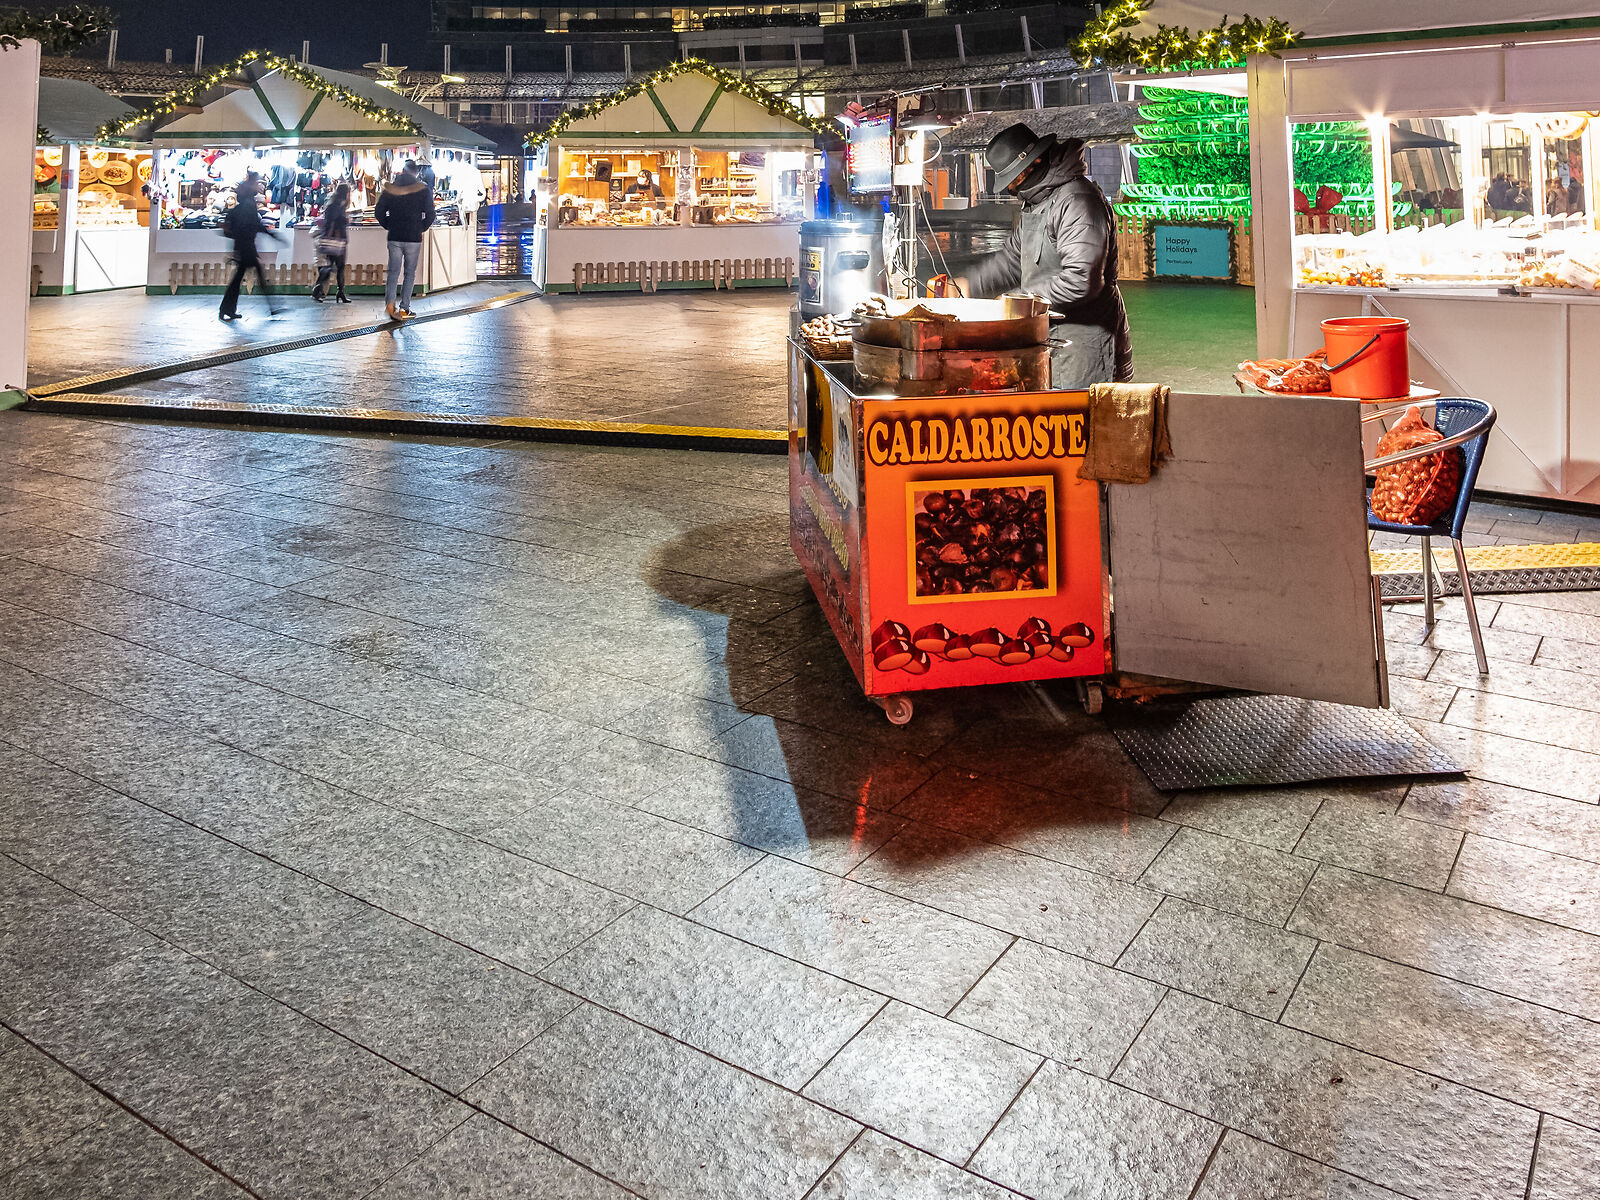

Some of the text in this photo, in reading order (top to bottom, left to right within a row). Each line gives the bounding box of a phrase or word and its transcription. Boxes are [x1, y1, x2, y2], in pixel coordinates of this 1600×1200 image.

[1165, 237, 1191, 245] Happy
[1165, 245, 1198, 254] Holidays
[868, 412, 1088, 465] CALDARROSTE
